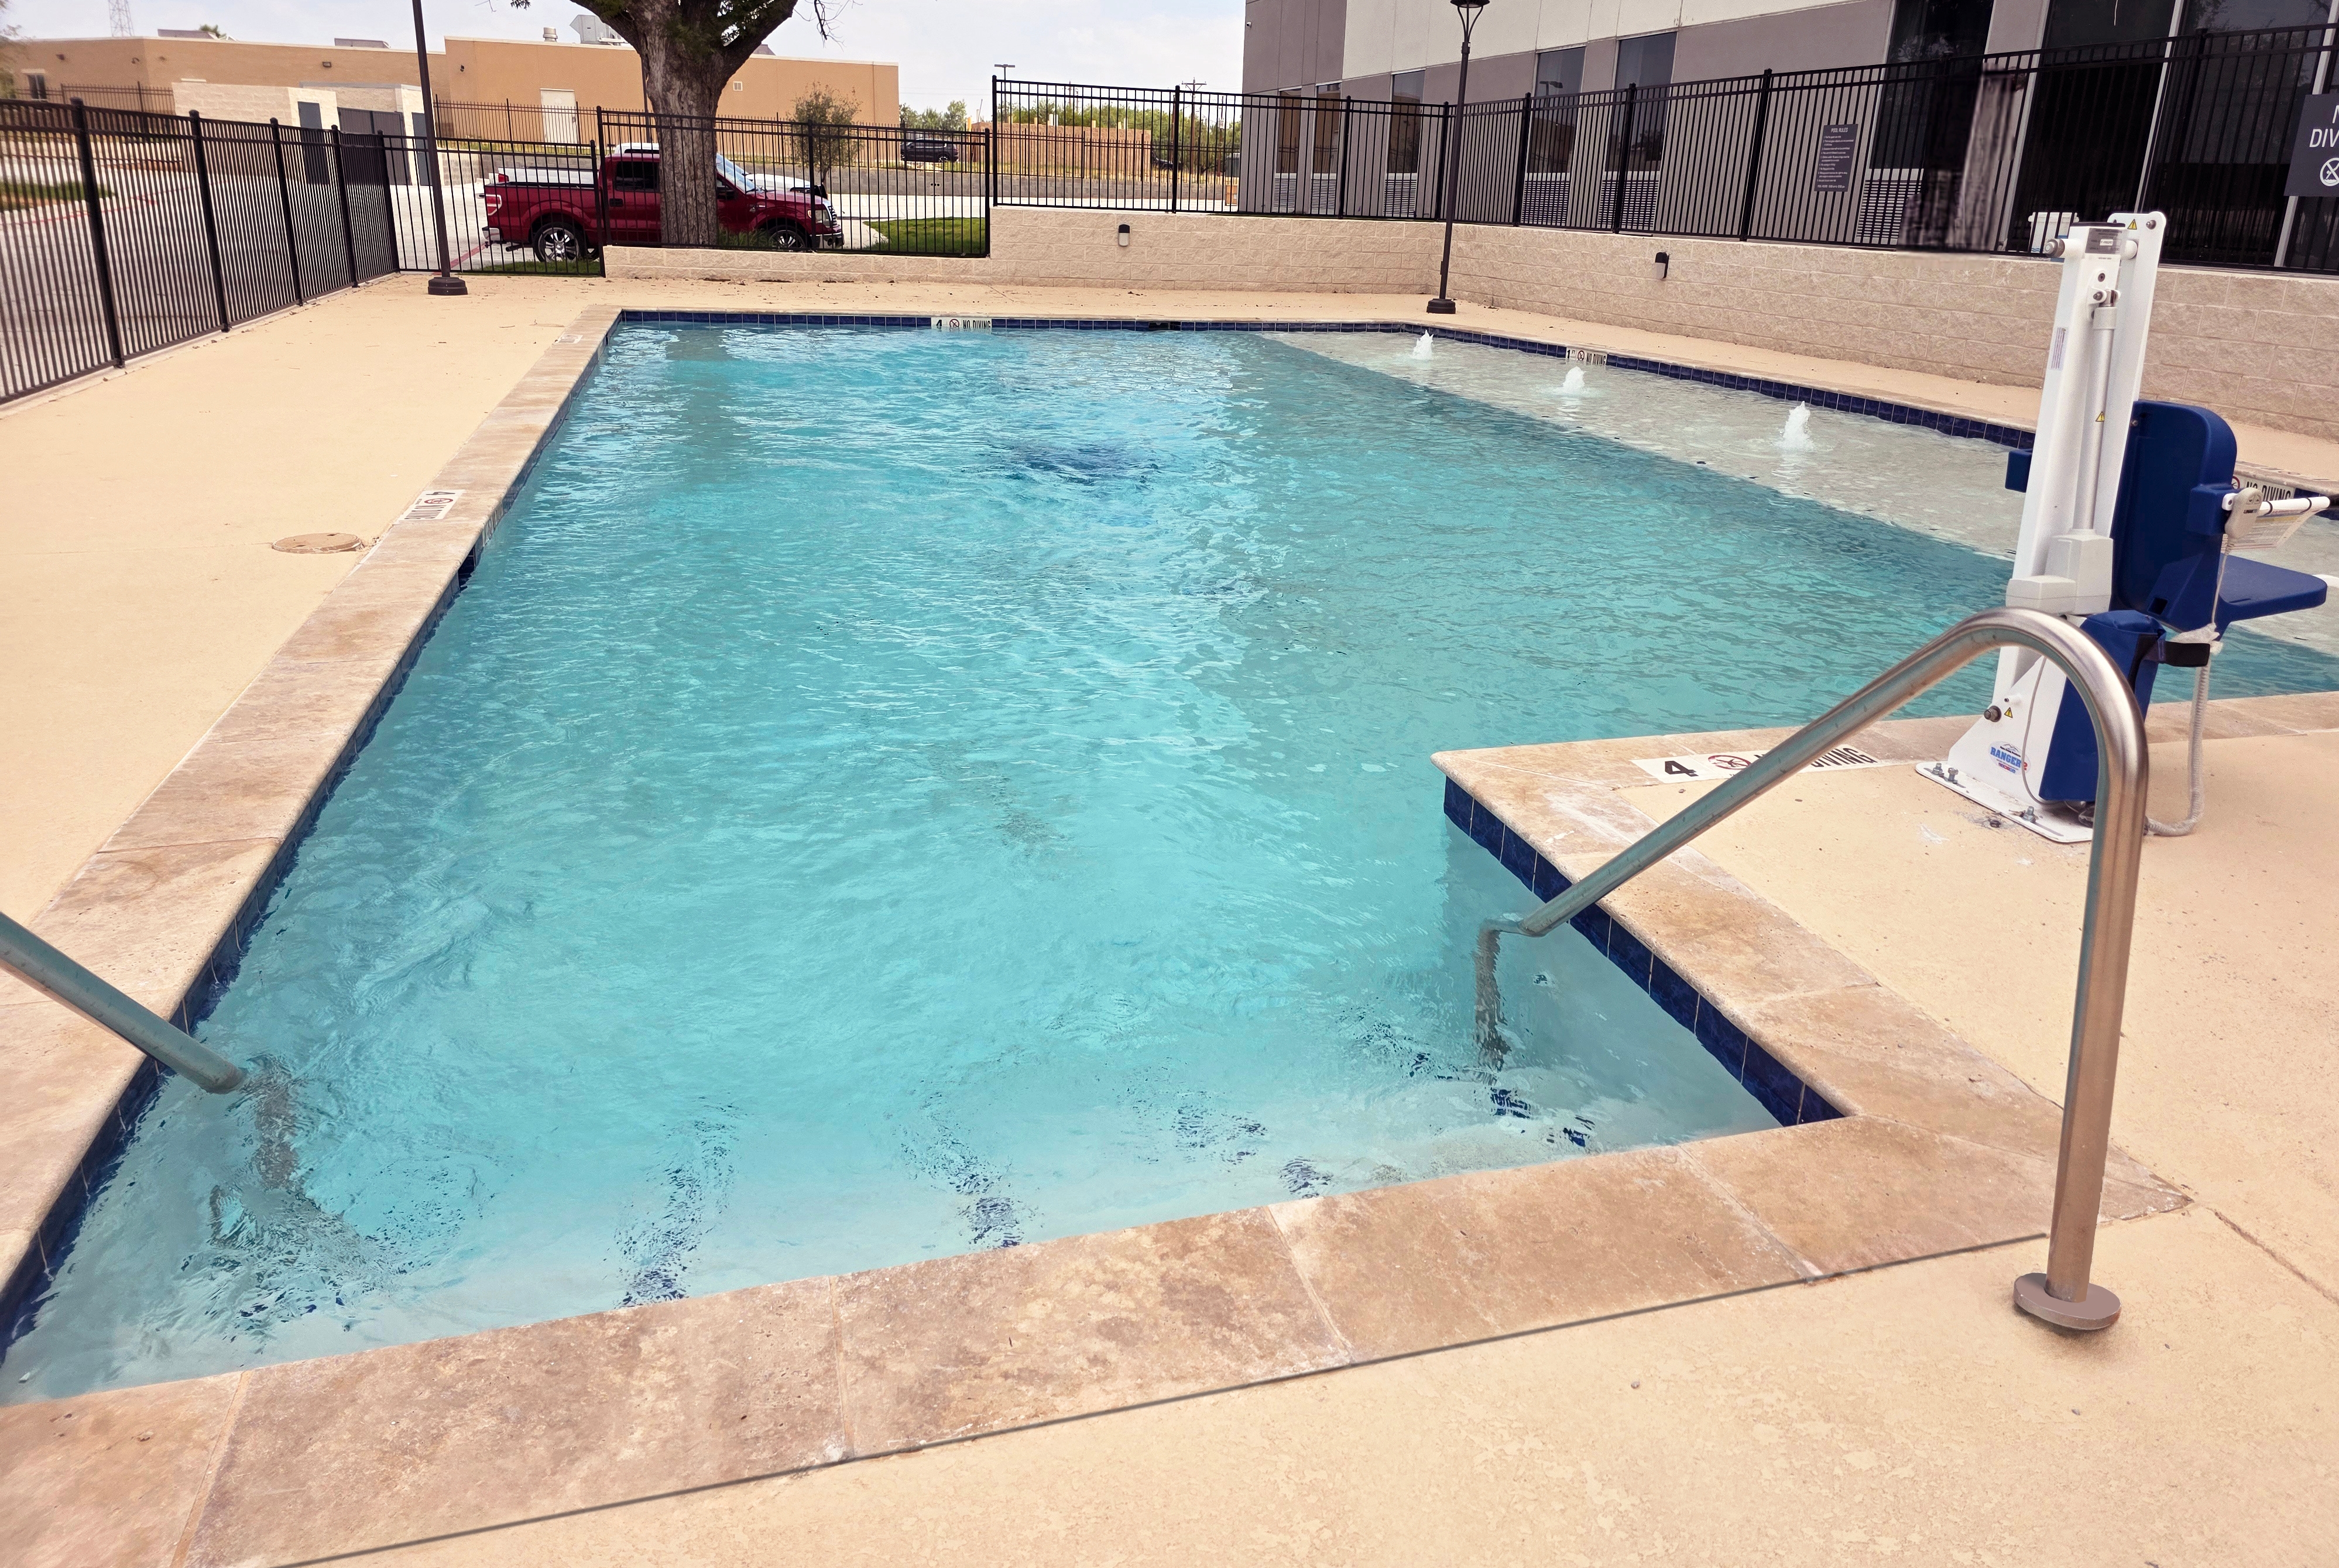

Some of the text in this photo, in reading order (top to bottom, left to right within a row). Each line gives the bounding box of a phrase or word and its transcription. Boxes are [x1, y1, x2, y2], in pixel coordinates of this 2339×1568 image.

[963, 320, 970, 330] NO
[972, 320, 991, 330] DIVING
[1567, 349, 1570, 359] 1
[1990, 746, 2022, 768] RANGER
[1665, 761, 1699, 777] 4
